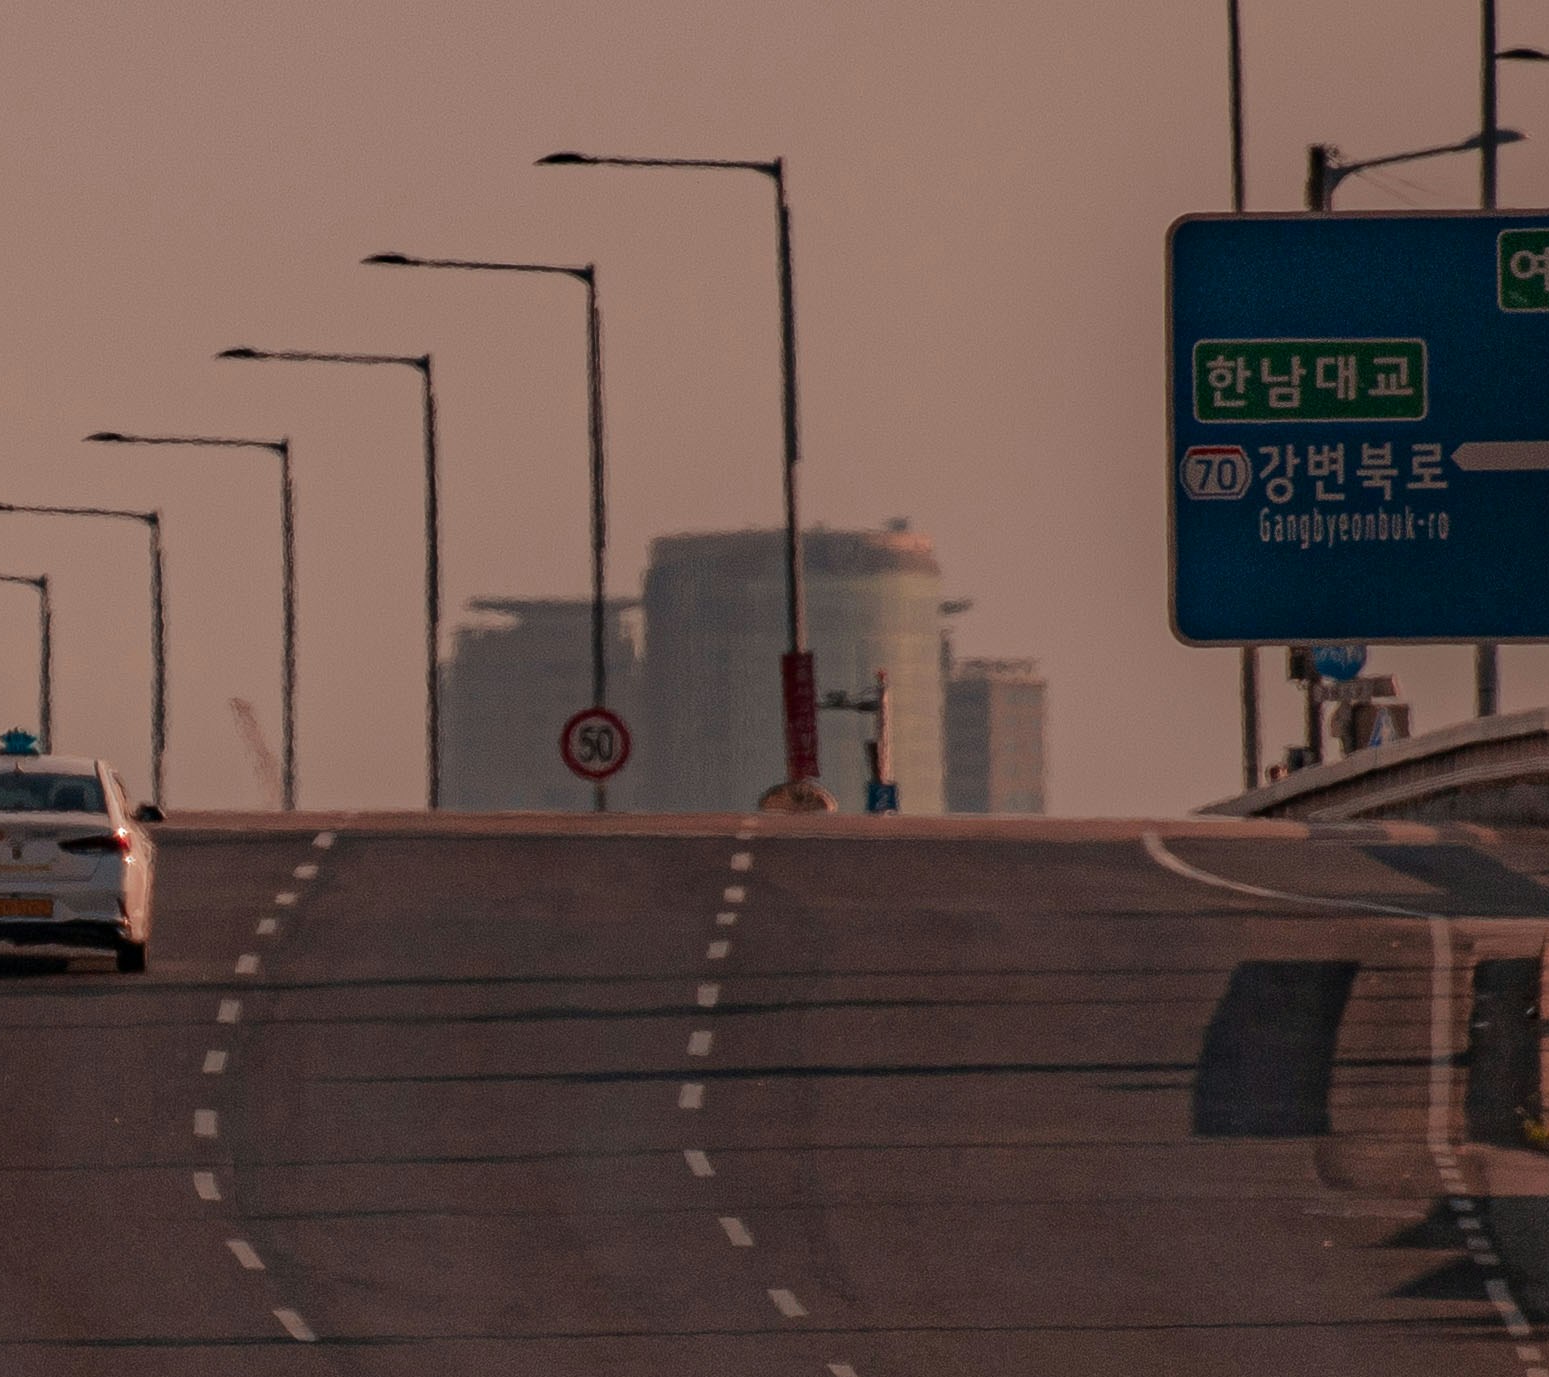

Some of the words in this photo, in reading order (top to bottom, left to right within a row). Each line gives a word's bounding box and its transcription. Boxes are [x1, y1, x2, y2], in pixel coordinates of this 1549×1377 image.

[1206, 354, 1414, 409] 한남대교
[1196, 459, 1238, 490] 70
[1258, 442, 1449, 504] 강변북로
[1258, 506, 1450, 550] Gangbyeonbuk-ro
[578, 725, 614, 763] 50
